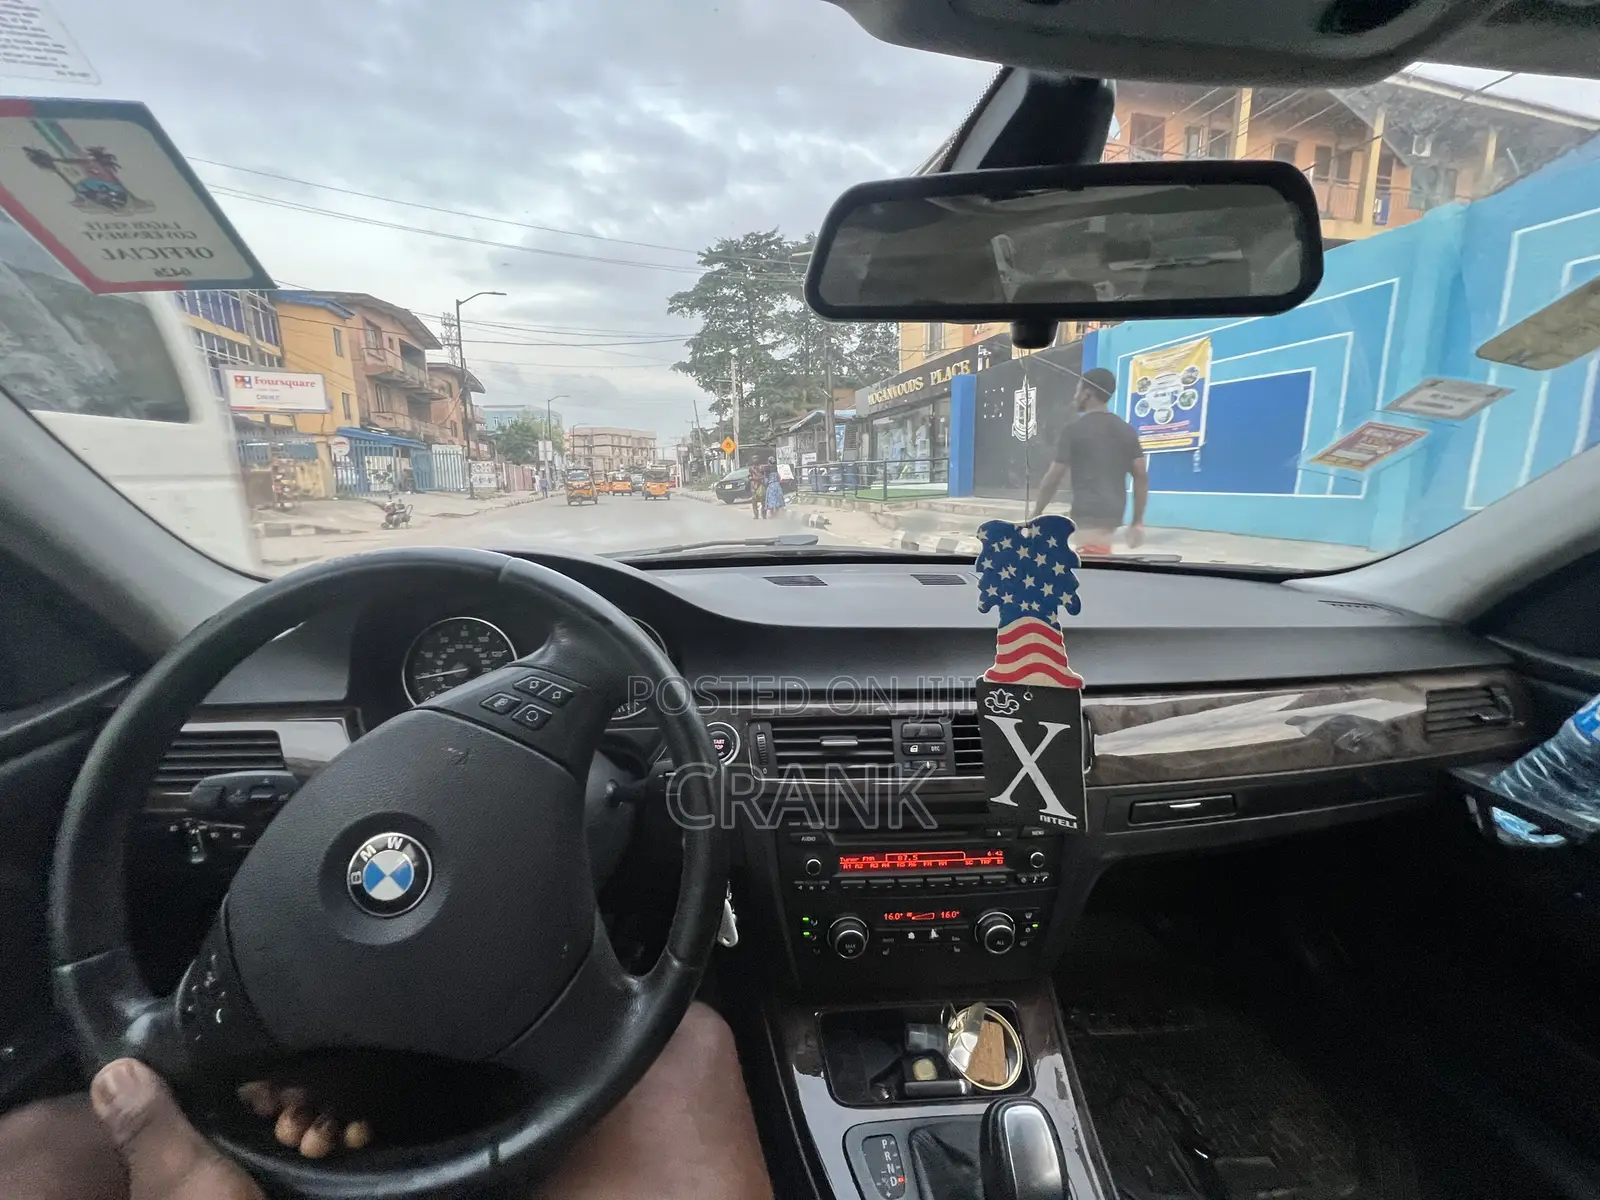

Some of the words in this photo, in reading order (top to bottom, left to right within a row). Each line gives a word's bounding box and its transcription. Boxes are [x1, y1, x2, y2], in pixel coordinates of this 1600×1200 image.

[930, 360, 970, 386] PLACE
[255, 376, 316, 388] Foursquare
[984, 714, 1078, 820] X
[350, 836, 404, 886] BMW
[881, 1139, 888, 1149] P
[884, 1151, 892, 1161] R
[887, 1163, 895, 1174] N
[889, 1176, 897, 1187] D
